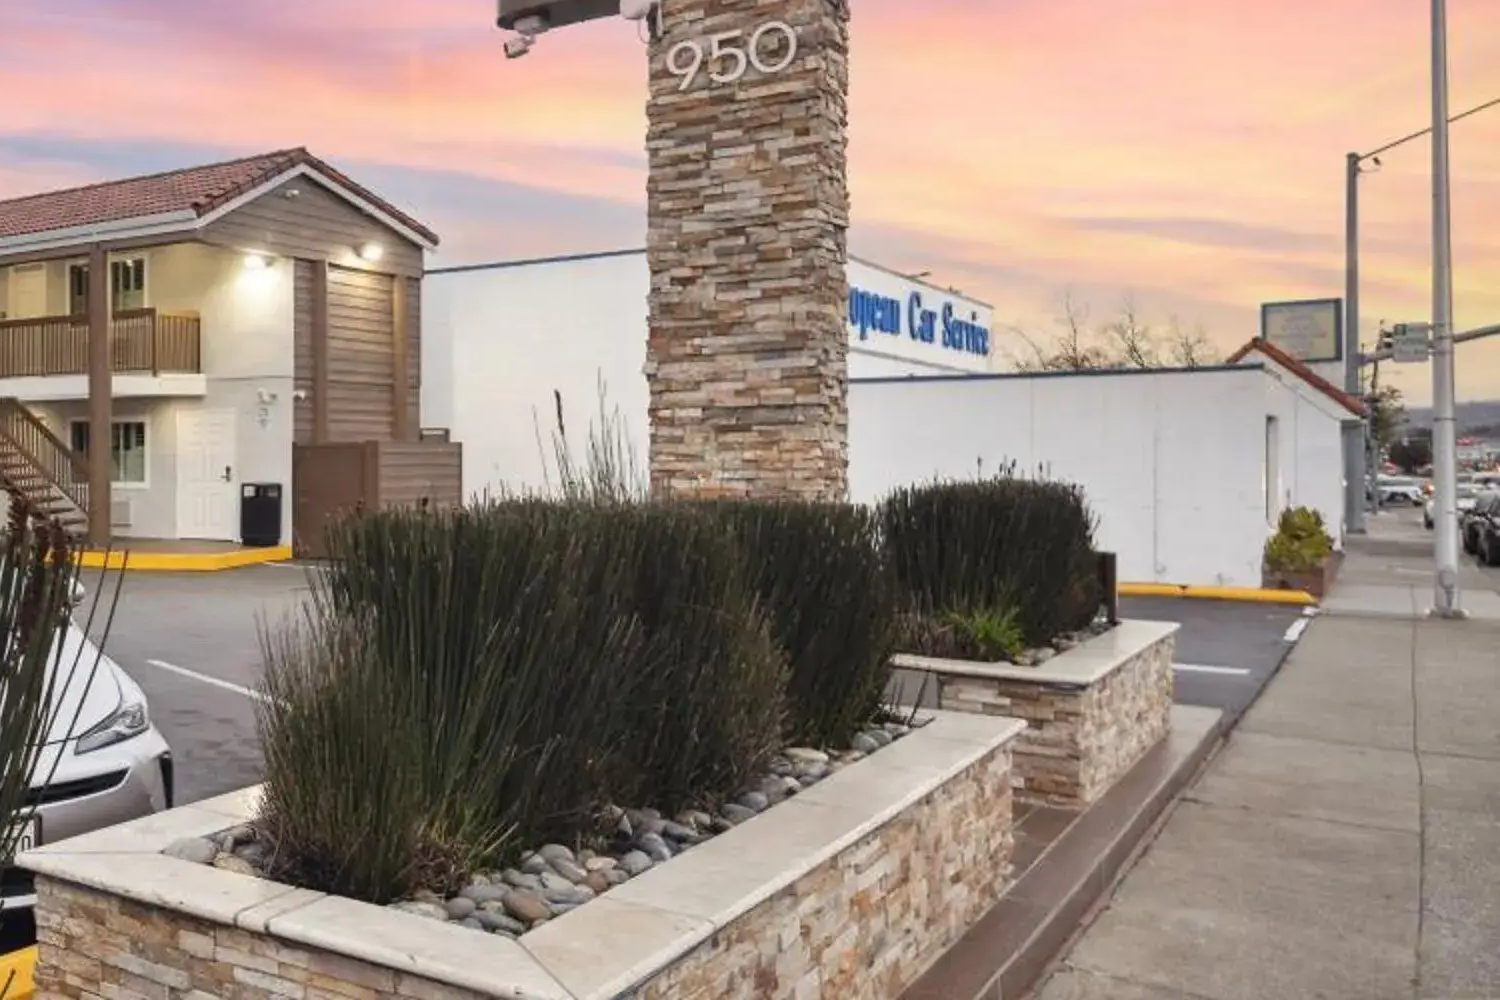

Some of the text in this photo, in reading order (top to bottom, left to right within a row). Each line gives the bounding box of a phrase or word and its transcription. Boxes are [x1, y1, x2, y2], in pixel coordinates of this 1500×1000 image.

[666, 21, 797, 91] 950
[908, 291, 937, 344] Car
[942, 301, 989, 356] Service
